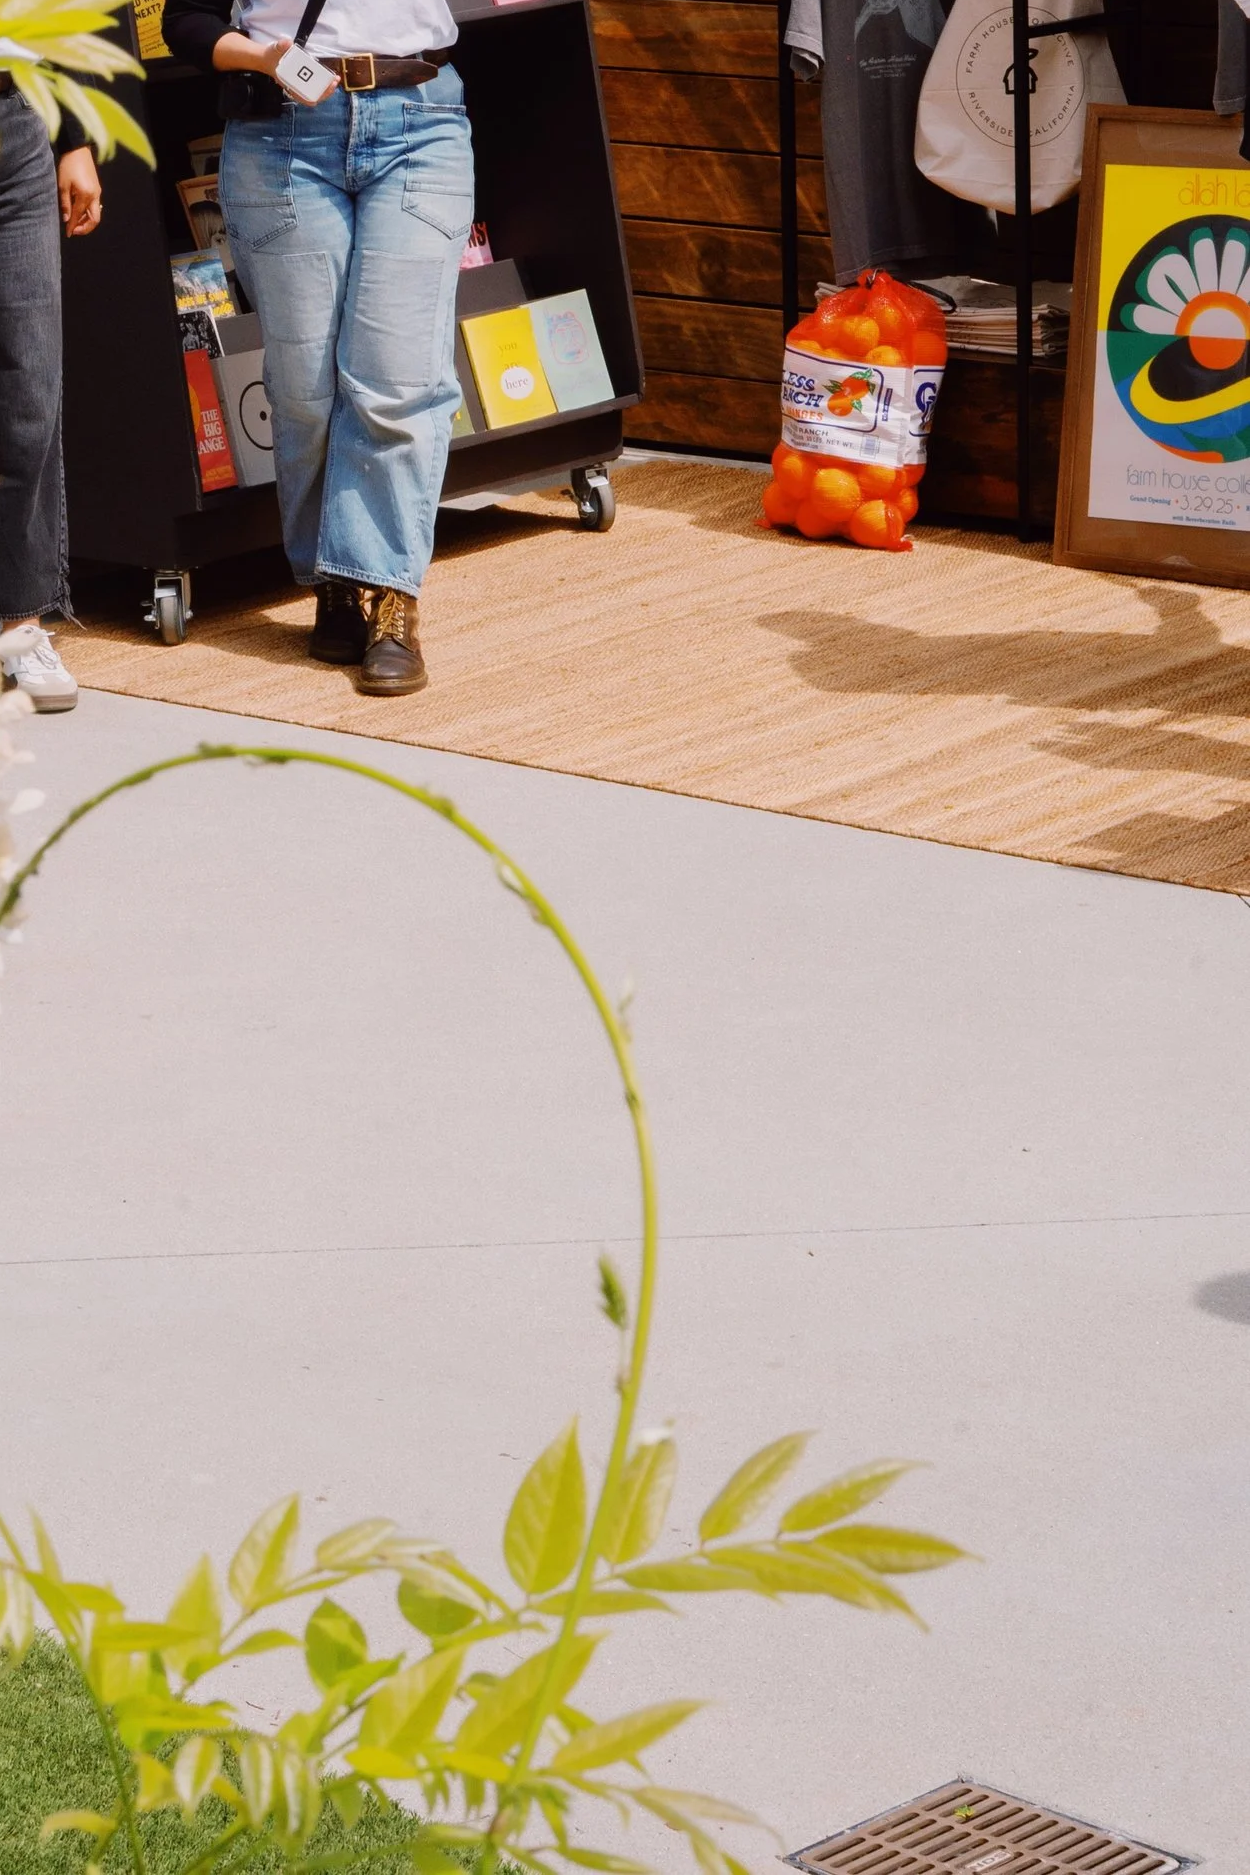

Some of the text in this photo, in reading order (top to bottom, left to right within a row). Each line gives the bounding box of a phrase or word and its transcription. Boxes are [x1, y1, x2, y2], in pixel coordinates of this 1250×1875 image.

[135, 2, 161, 21] NEXT?
[966, 42, 981, 74] FARM
[982, 16, 1014, 39] HOUSE
[968, 91, 1013, 138] RIVERSIDE
[1178, 172, 1228, 206] allah
[498, 341, 518, 357] you
[504, 376, 529, 390] here
[200, 409, 220, 423] THE
[203, 422, 223, 438] BIG
[197, 437, 226, 455] ANGE
[1126, 464, 1157, 486] farm
[1162, 468, 1211, 492] house
[1129, 494, 1234, 515] Grand Opening 3.29.25
